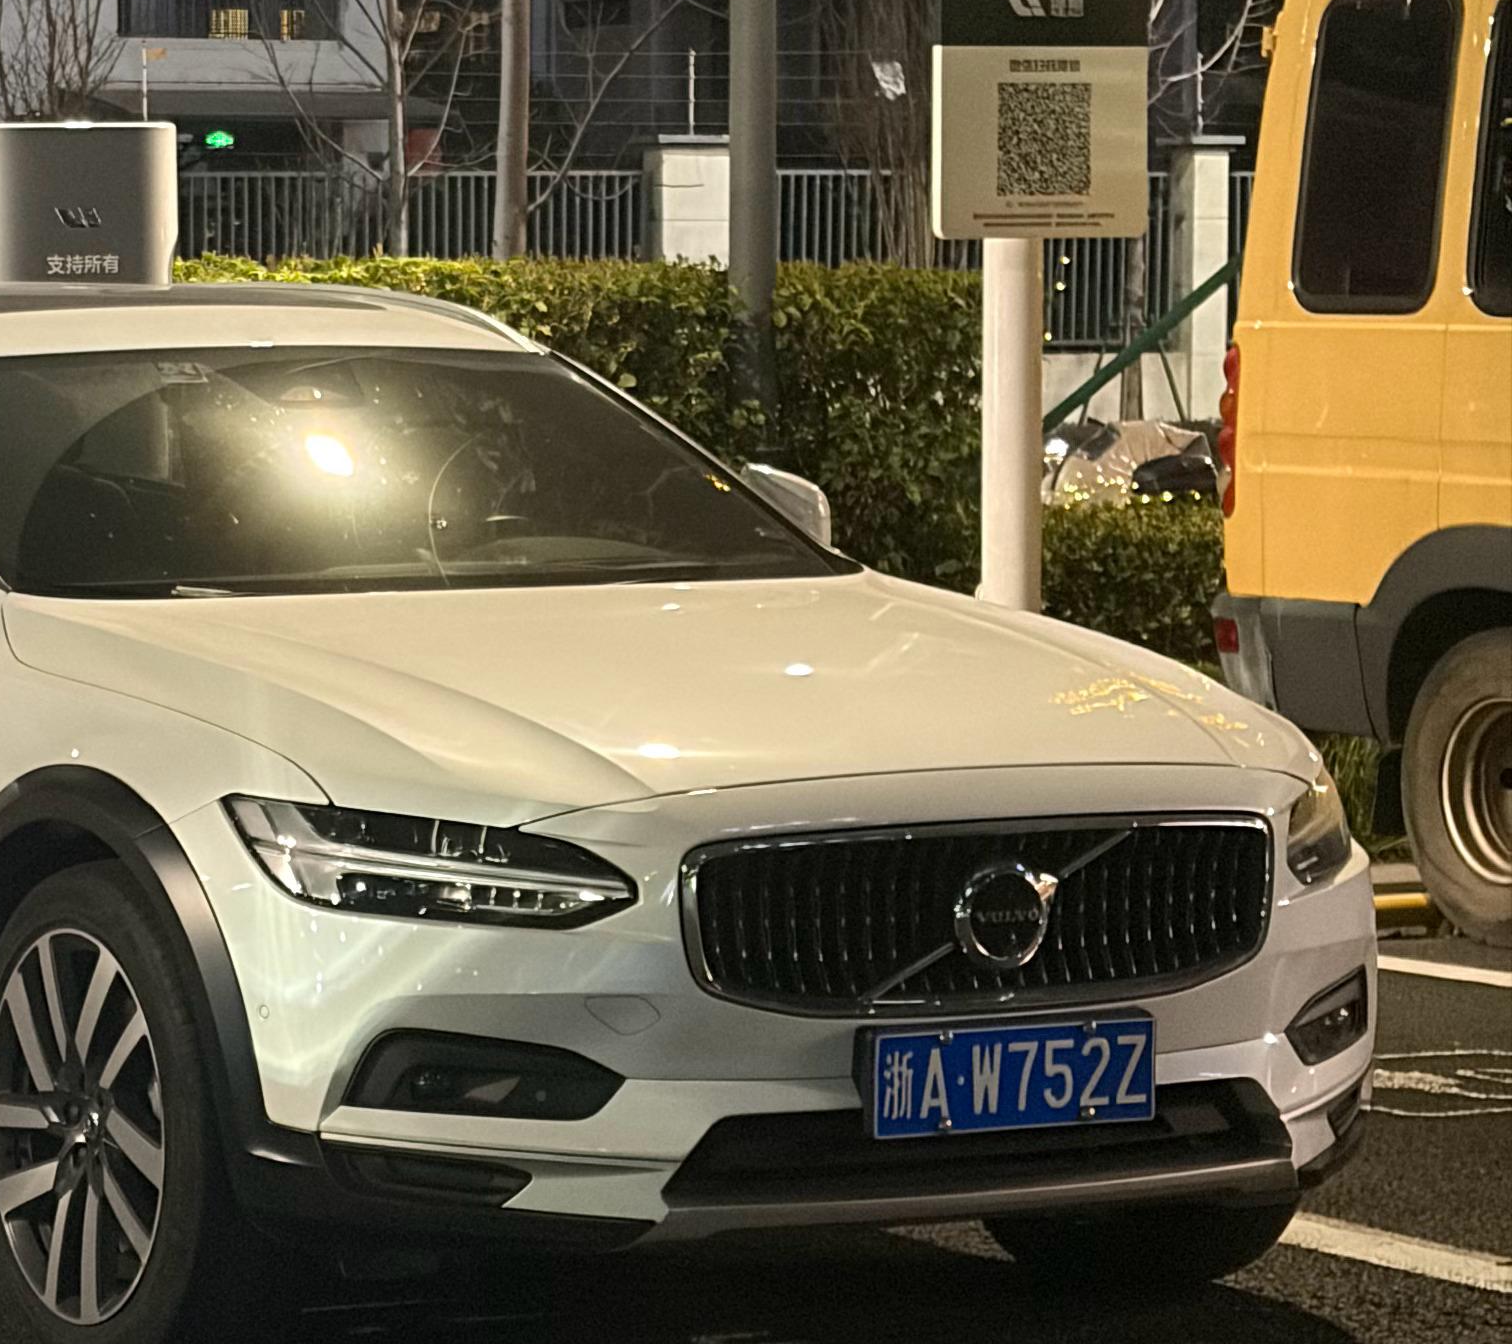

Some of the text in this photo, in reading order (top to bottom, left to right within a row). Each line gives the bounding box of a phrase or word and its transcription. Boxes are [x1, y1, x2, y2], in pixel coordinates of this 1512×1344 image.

[46, 253, 119, 275] 支持所有
[975, 907, 1040, 924] VOLVO
